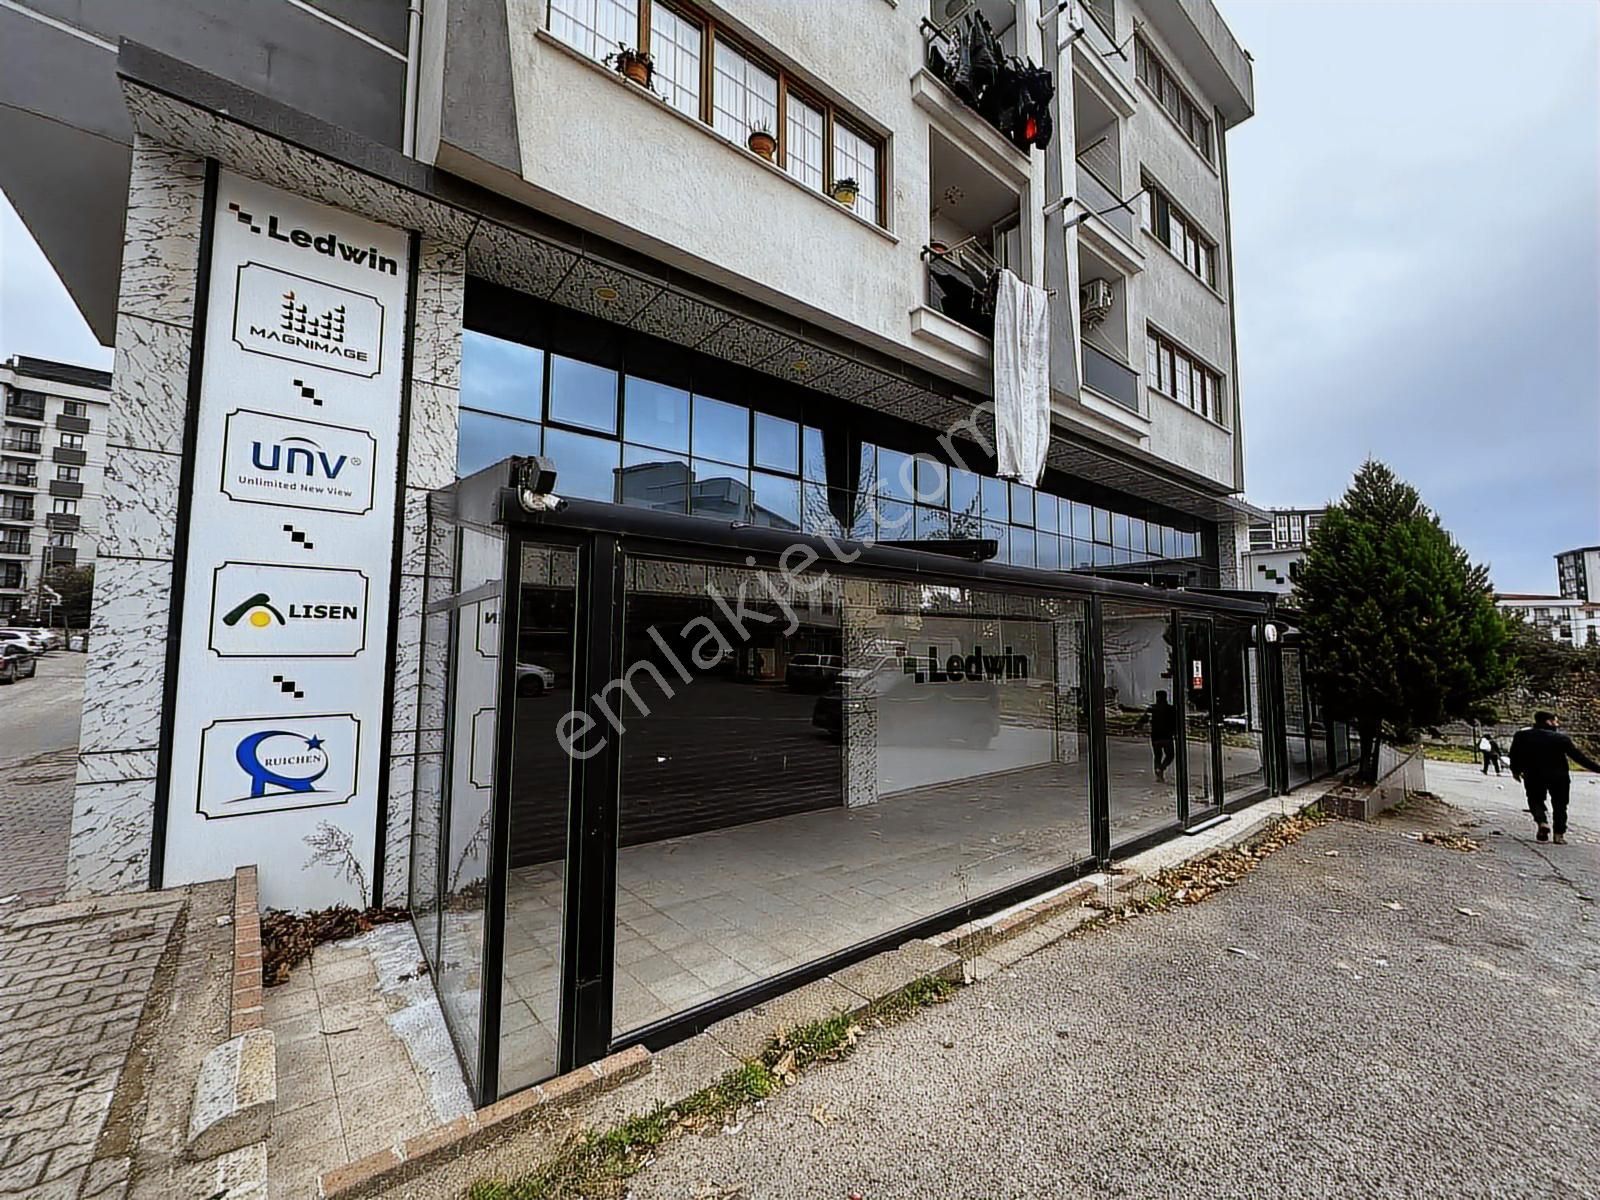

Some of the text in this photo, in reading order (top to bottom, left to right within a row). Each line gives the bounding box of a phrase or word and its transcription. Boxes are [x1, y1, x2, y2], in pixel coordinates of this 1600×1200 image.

[268, 216, 399, 276] Ledwin
[249, 325, 368, 363] MAGNIMAGE
[238, 475, 353, 498] Unlimited New View
[288, 603, 358, 620] LISEN
[928, 645, 1029, 683] Ledwin
[264, 753, 322, 767] RUICHEN
